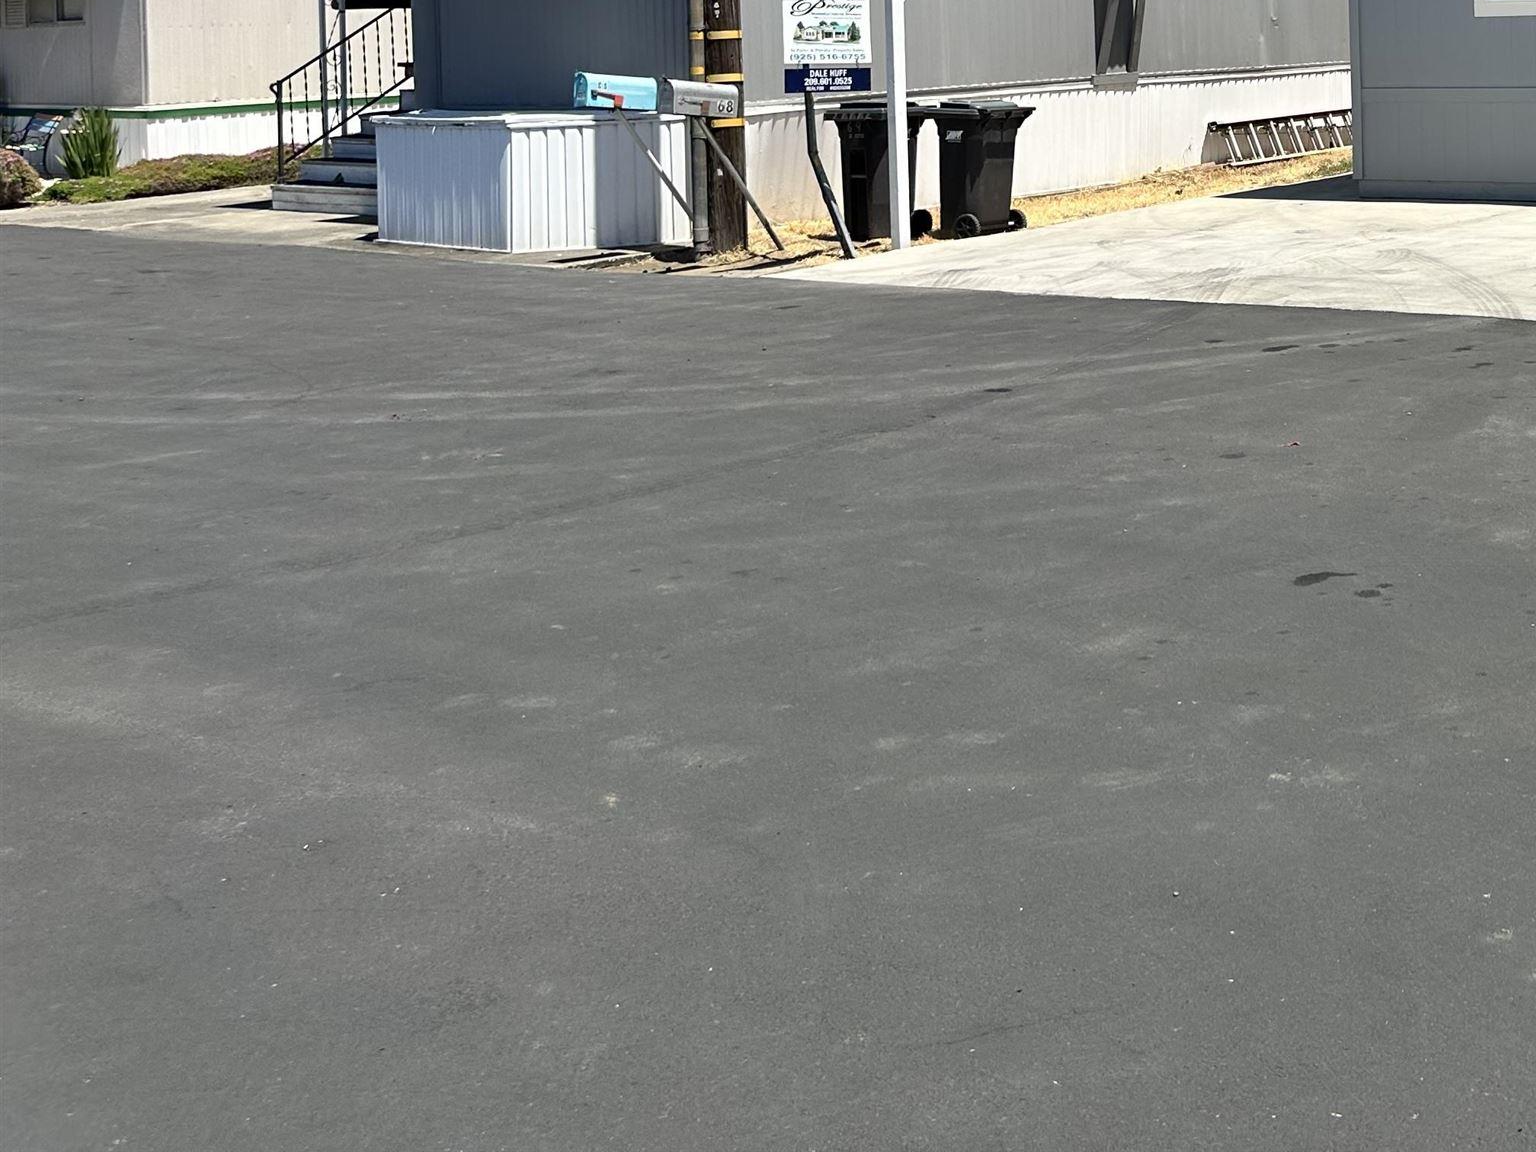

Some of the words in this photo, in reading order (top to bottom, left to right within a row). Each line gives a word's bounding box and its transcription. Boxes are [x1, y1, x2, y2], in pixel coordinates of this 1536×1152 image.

[789, 53, 816, 61] (925)
[819, 53, 866, 61] 516-6755
[809, 69, 828, 78] DALE
[717, 100, 734, 113] 68
